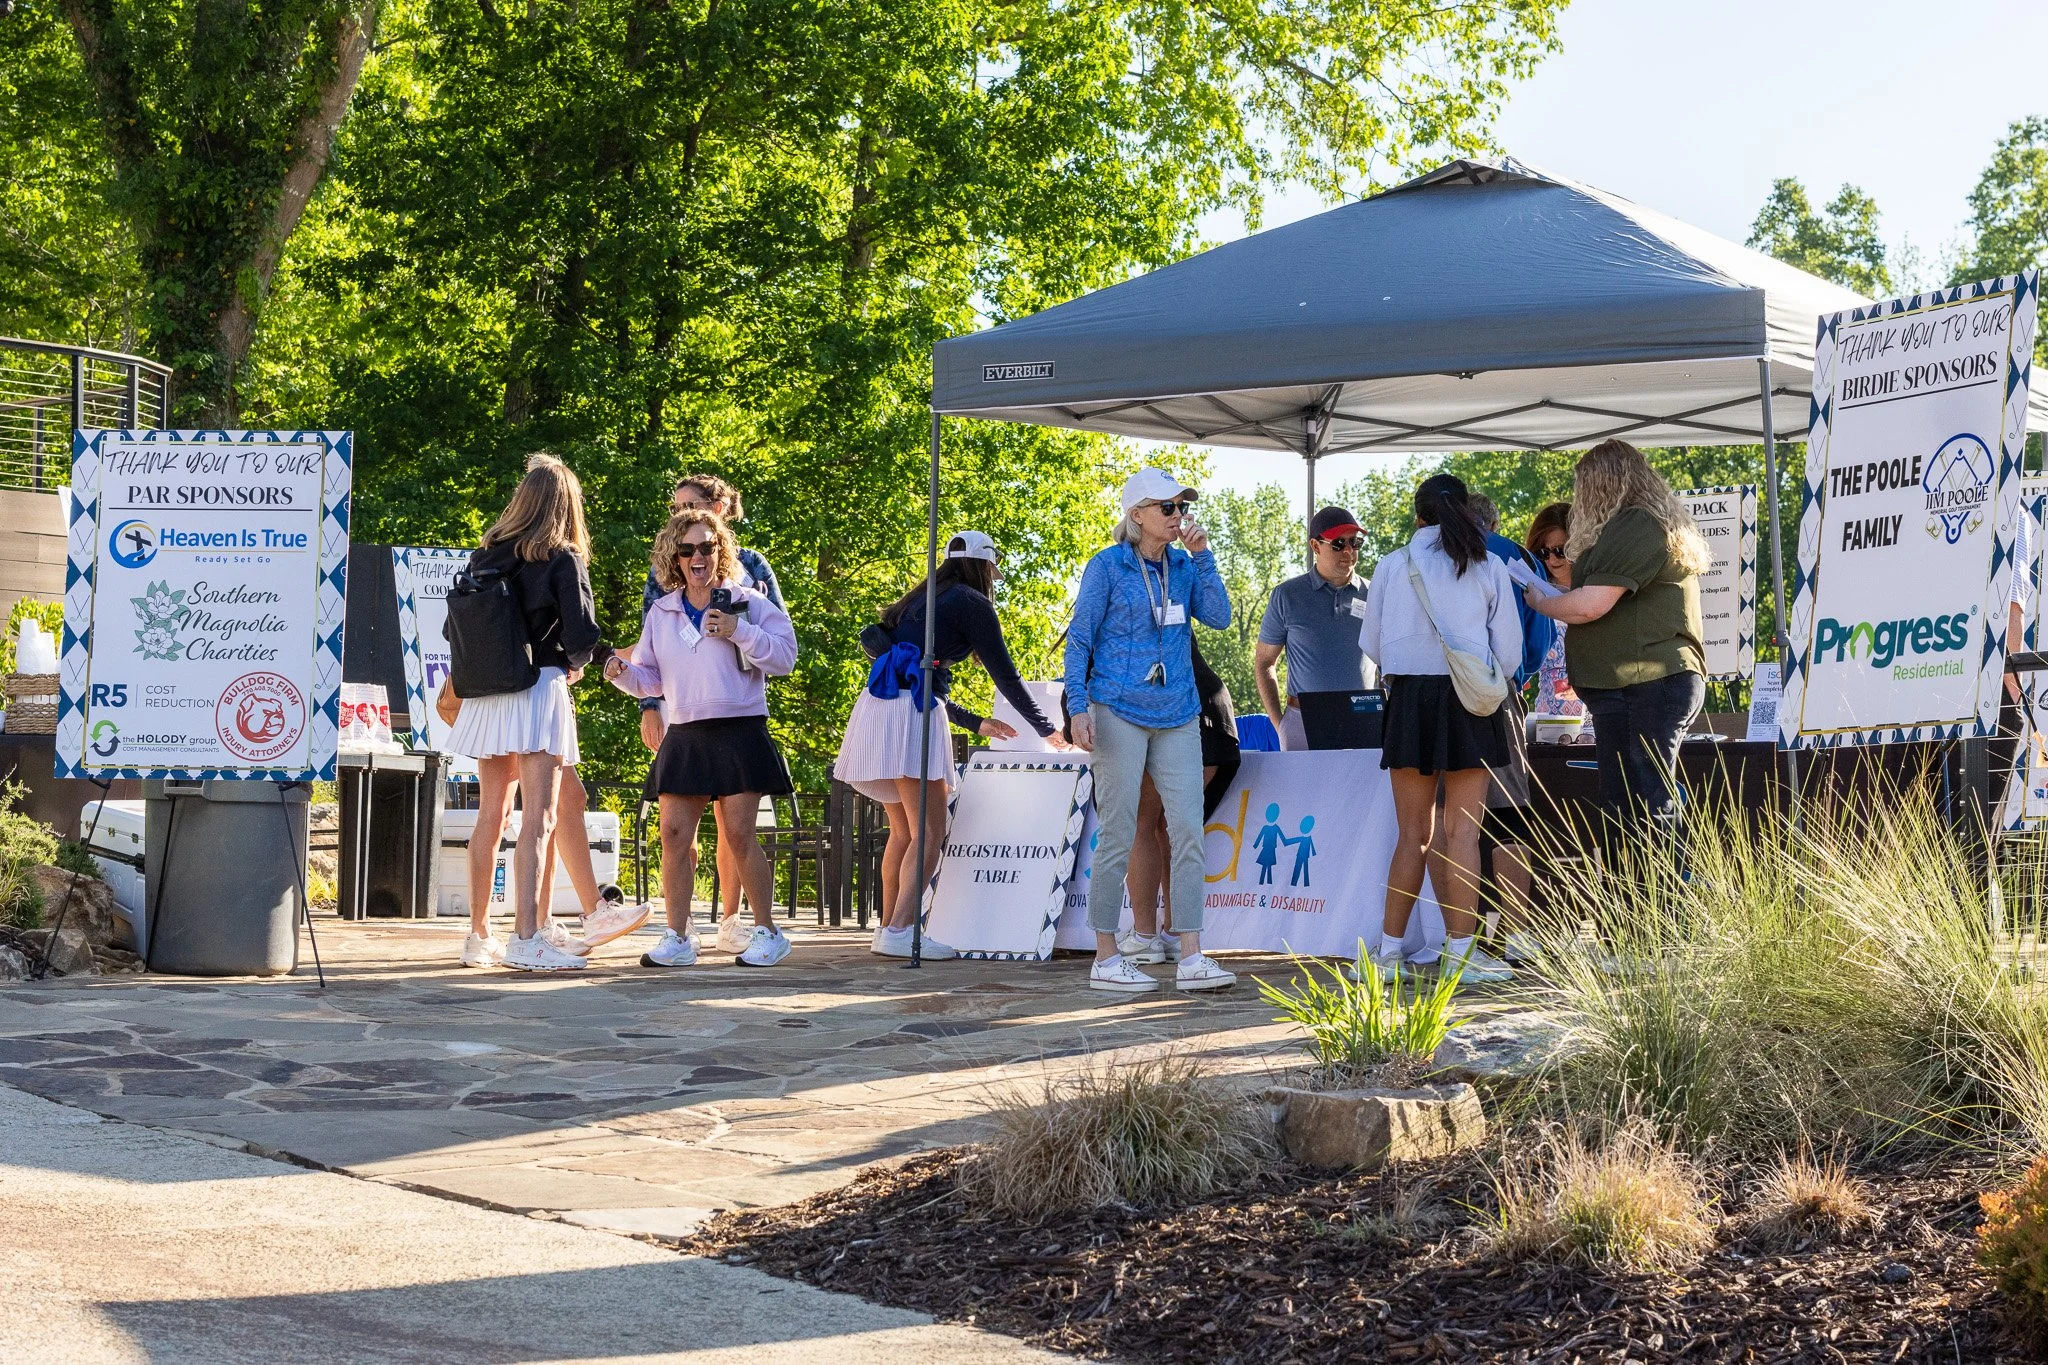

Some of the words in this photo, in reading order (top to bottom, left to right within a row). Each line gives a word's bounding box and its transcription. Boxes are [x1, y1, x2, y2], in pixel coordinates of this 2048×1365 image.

[1839, 328, 1896, 365] THANK
[1902, 320, 1936, 352] YOU
[1941, 313, 1967, 344] TO
[1973, 304, 2012, 337] OUR
[986, 364, 1052, 380] EVERBILT
[1842, 369, 1899, 401] BIRDIE
[1903, 351, 1998, 391] SPONSORS
[105, 451, 179, 476] THANK
[186, 452, 230, 475] YOU
[235, 452, 268, 474] TO
[275, 452, 322, 475] OUR
[1831, 464, 1862, 498] THE
[1866, 455, 1922, 493] POOLE
[128, 486, 170, 504] PAR
[176, 486, 293, 505] SPONSORS
[1925, 492, 1945, 510] JIM
[1948, 486, 1988, 506] POOLE
[1692, 501, 1728, 516] PACK
[160, 528, 237, 547] Heaven
[242, 529, 256, 548] Is
[261, 529, 307, 548] True
[1702, 526, 1730, 538] UDES:
[1842, 514, 1903, 552] FAMILY
[195, 556, 228, 564] Ready
[412, 562, 453, 578] THANK
[187, 580, 281, 605] Southern
[424, 584, 450, 595] COO
[178, 609, 288, 641] Magnolia
[186, 637, 278, 662] Charities
[1893, 659, 1964, 680] Residential
[91, 684, 128, 707] R5
[146, 686, 176, 694] COST
[224, 676, 274, 705] BULLDOG
[276, 681, 299, 706] FIRM
[146, 699, 214, 708] REDUCTION
[137, 735, 187, 744] HOLODY
[189, 737, 216, 745] group
[222, 727, 247, 754] INJURY
[249, 728, 298, 757] ATTORNEYS
[946, 845, 1060, 859] REGISTRATION
[973, 870, 1021, 884] TABLE
[1205, 893, 1257, 908] ADVANTAGE
[1259, 894, 1266, 908] &
[1271, 896, 1326, 913] DISABILITY
